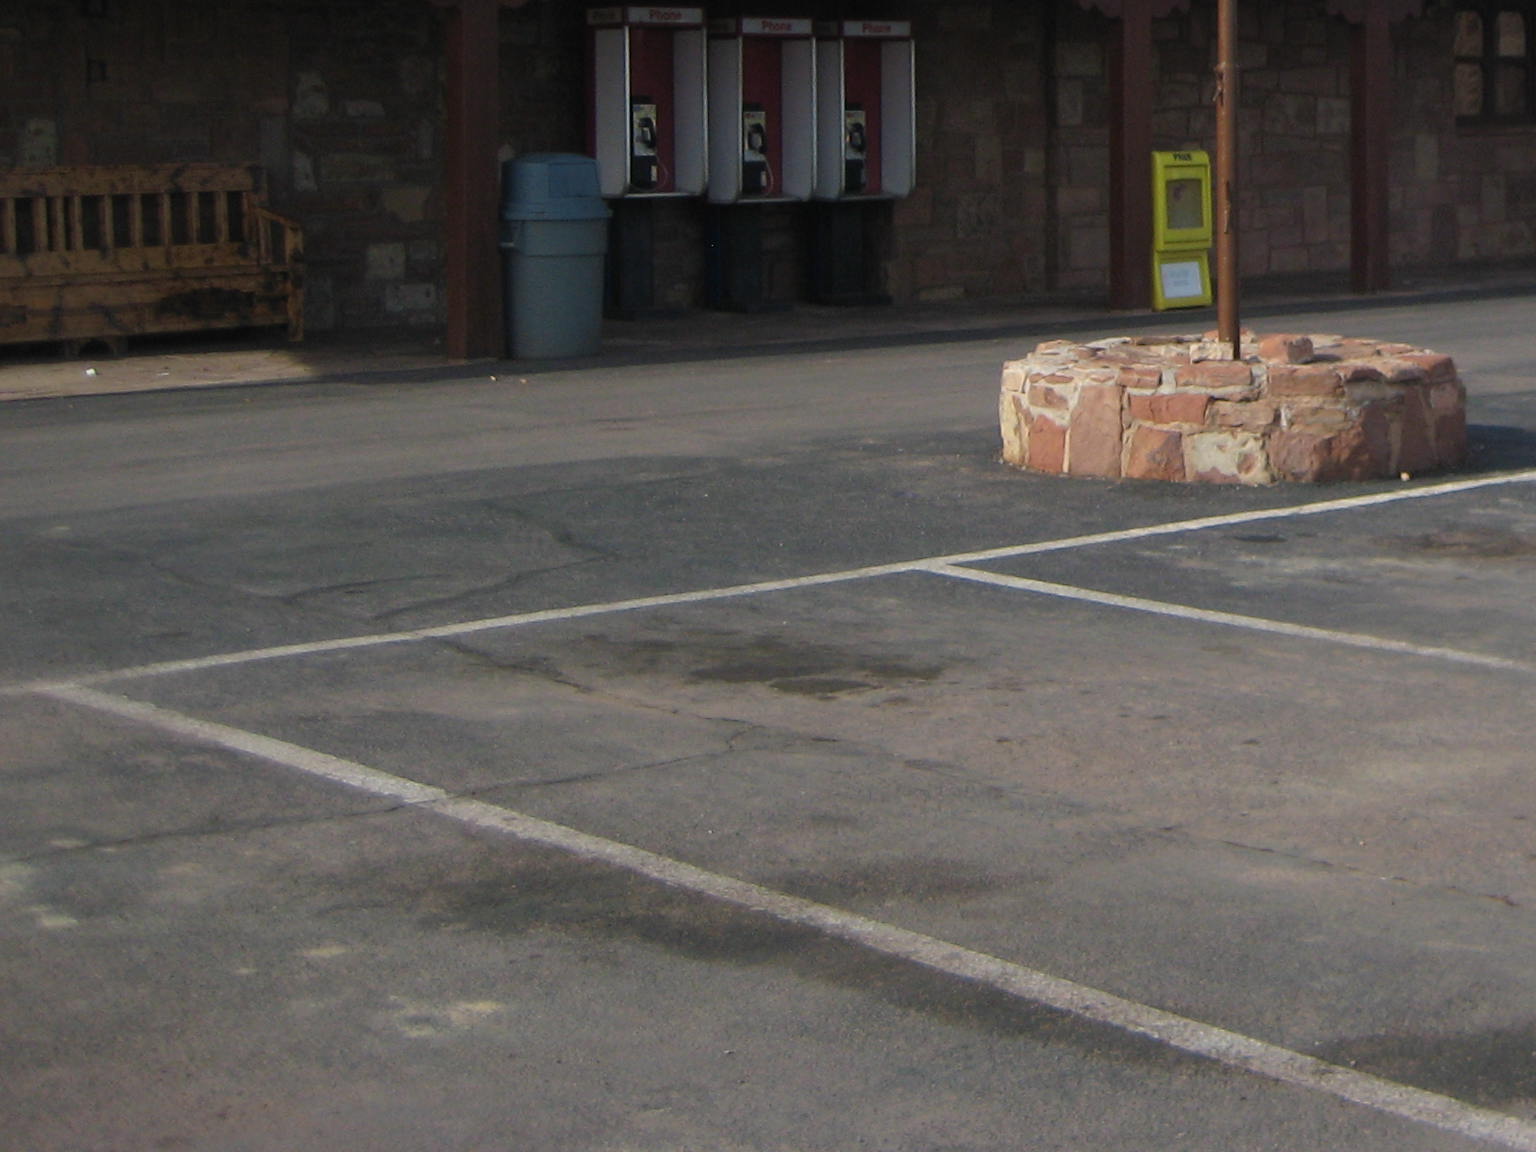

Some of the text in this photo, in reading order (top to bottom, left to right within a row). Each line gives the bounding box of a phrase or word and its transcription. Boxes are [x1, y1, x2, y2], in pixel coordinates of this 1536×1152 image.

[648, 8, 682, 21] Phone
[761, 20, 792, 32] Phone
[862, 23, 892, 34] Phone
